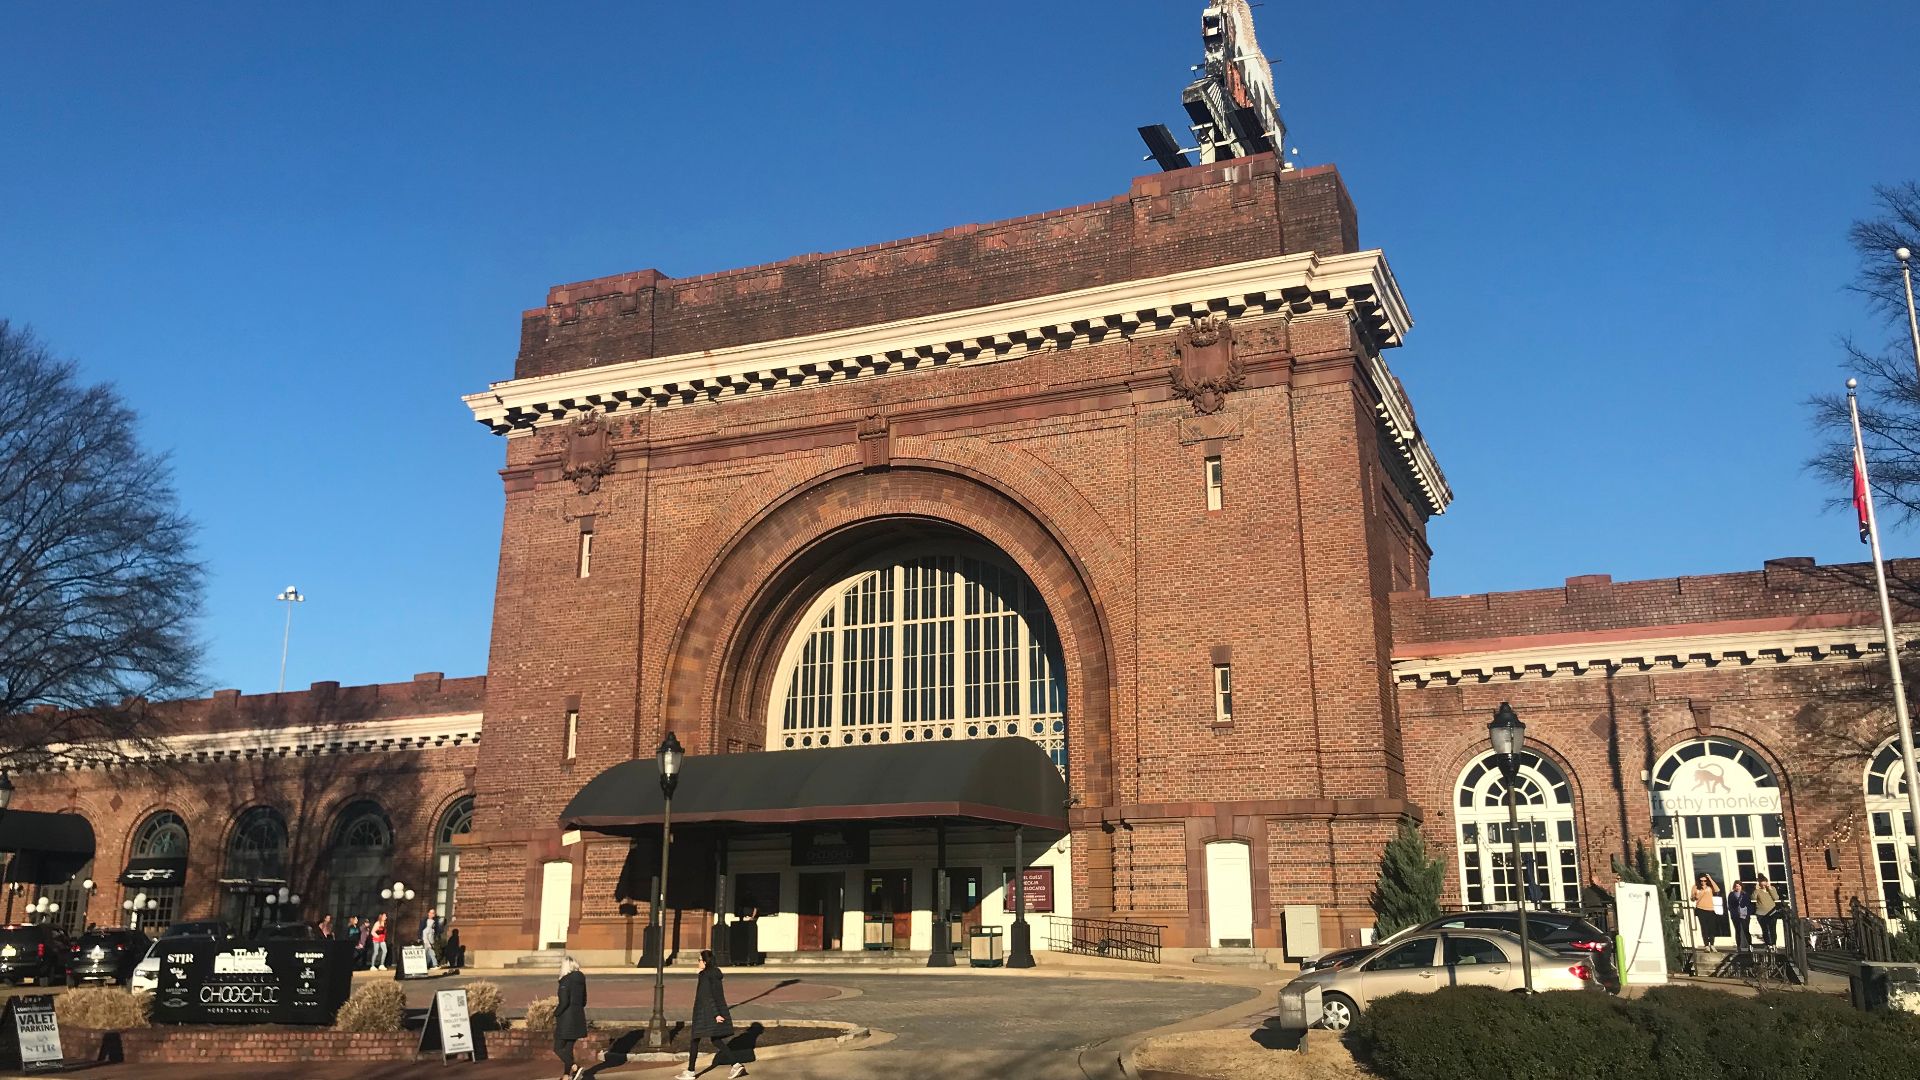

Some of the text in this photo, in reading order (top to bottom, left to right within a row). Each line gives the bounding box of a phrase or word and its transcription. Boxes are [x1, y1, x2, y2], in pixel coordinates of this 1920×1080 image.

[1651, 792, 1779, 813] frothy monkey
[167, 953, 194, 964] STIR
[18, 1014, 54, 1025] VALET
[20, 1024, 56, 1033] PARKING
